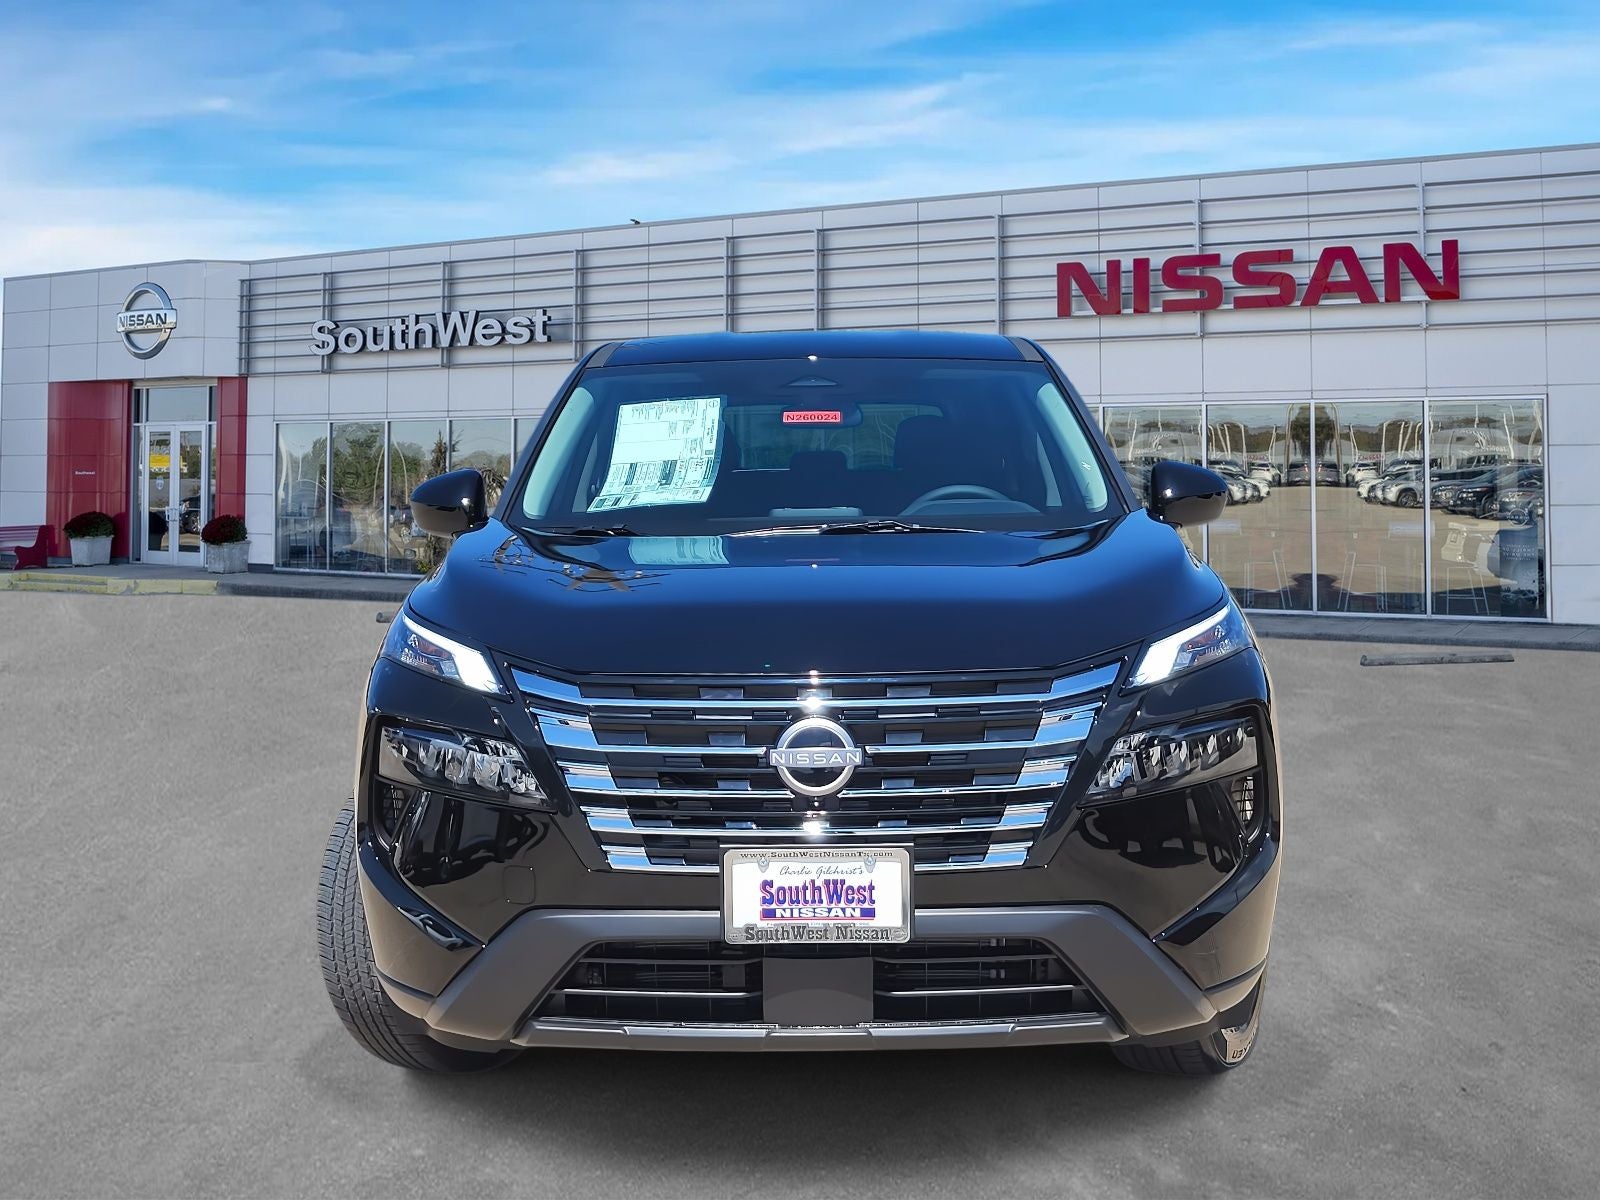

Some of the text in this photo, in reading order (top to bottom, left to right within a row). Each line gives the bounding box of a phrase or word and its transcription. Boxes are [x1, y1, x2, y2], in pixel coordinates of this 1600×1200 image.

[1056, 239, 1461, 318] NISSAN
[119, 312, 167, 328] NISSAN
[309, 307, 552, 356] SouthWest
[786, 413, 839, 422] N260024
[771, 752, 861, 765] NISSAN
[779, 865, 864, 880] Charlie Gilchrist's
[760, 878, 876, 906] SouthWest
[775, 907, 861, 918] NISSAN
[744, 925, 890, 941] SouthWest Nissan
